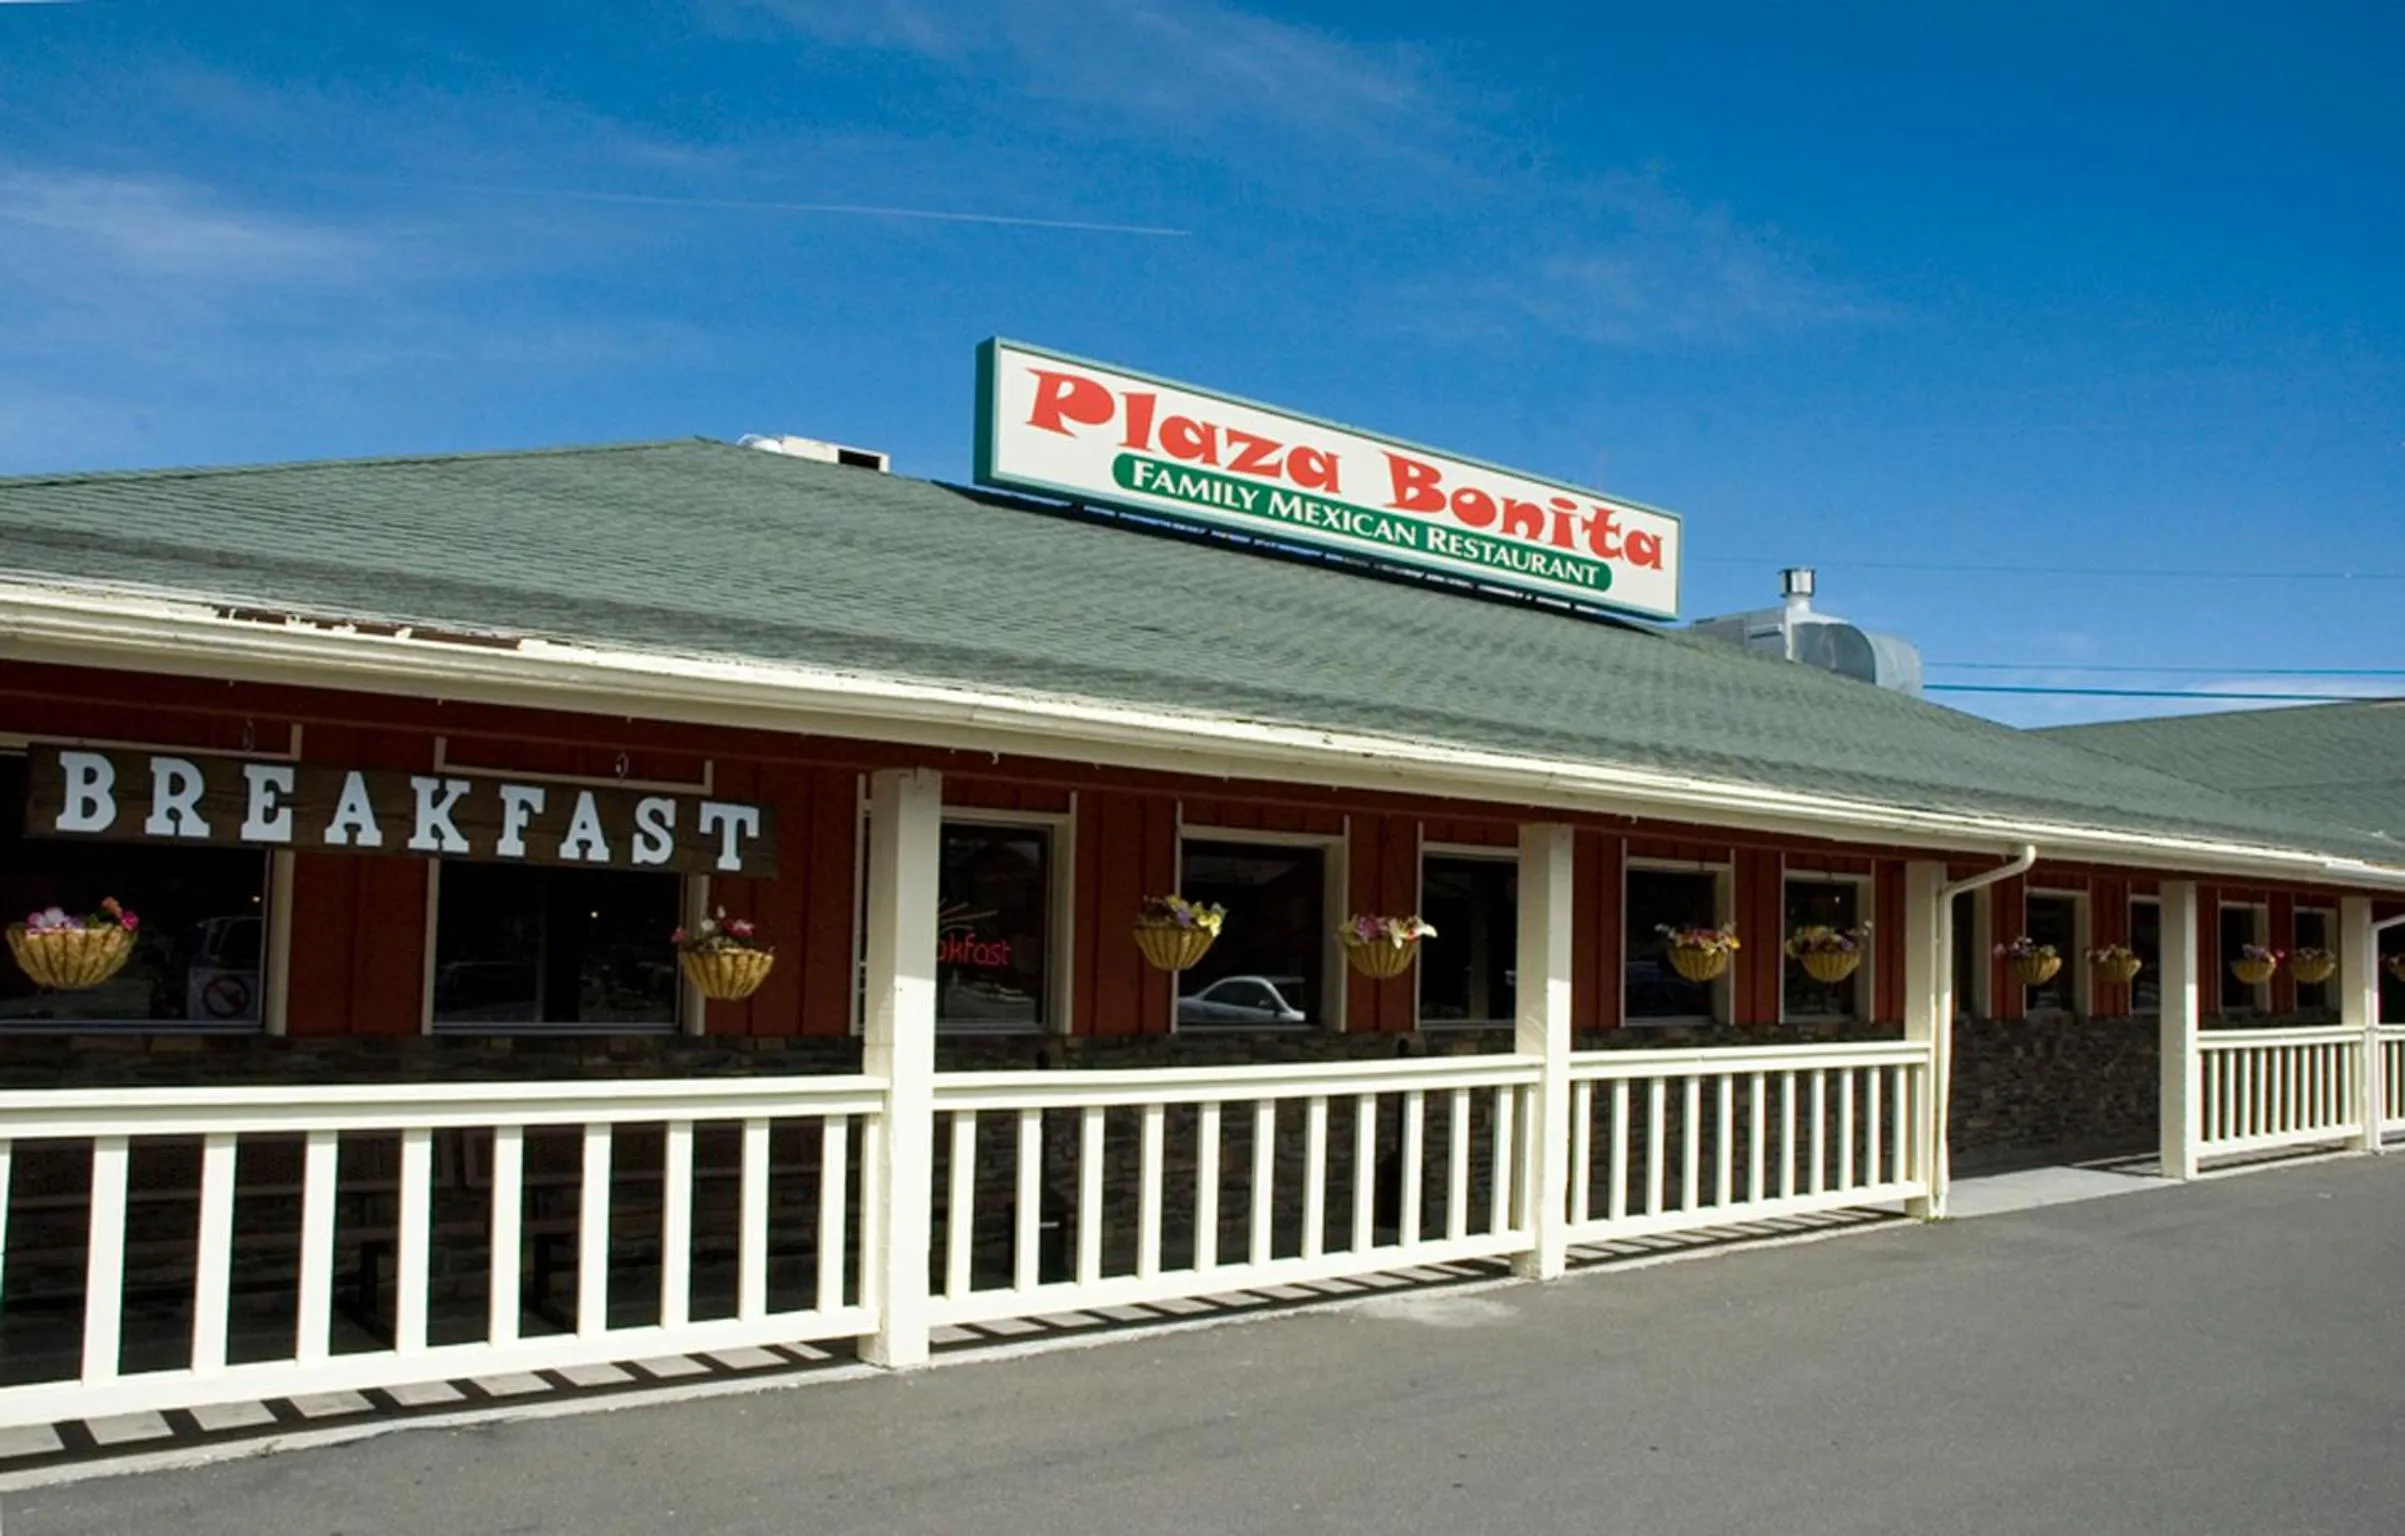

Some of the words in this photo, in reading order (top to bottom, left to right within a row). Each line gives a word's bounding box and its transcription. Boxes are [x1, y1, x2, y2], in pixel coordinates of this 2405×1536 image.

[1028, 367, 1341, 494] Plaza
[1382, 451, 1665, 570] Bonita
[1132, 459, 1260, 509] FAMILY
[1267, 490, 1417, 546] MEXICAN
[1426, 525, 1600, 586] RESTAURANT
[55, 750, 760, 872] BREAKFAST
